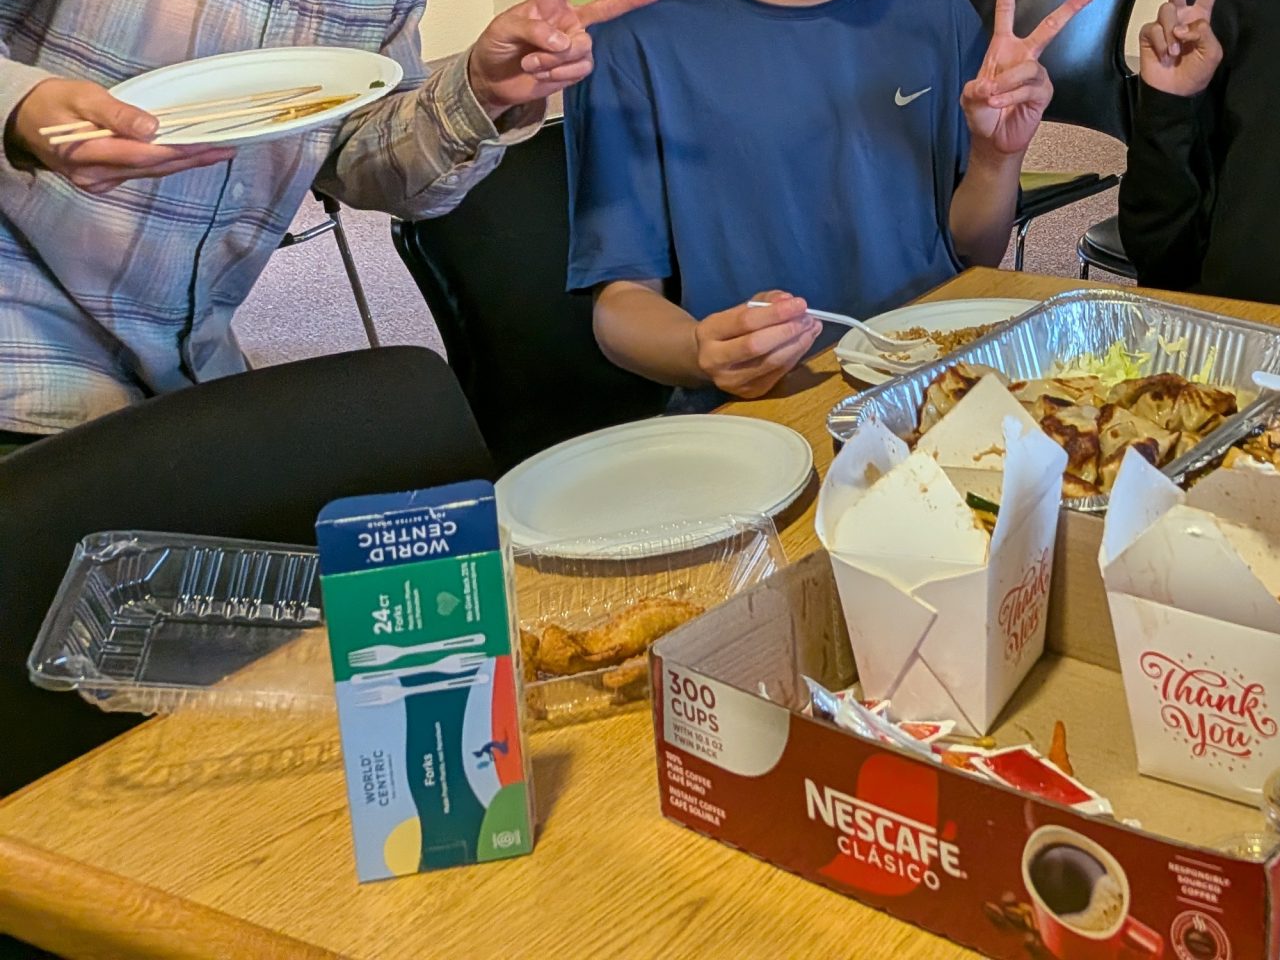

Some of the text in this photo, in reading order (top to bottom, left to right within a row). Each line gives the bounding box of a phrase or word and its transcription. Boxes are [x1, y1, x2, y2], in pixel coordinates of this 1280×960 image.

[358, 521, 458, 548] CENTRIC
[368, 538, 450, 563] WORLD
[393, 604, 405, 632] Forks
[668, 669, 716, 710] 300
[1139, 651, 1279, 737] Thank
[671, 697, 720, 733] CUPS
[673, 722, 693, 737] WITH
[1161, 704, 1254, 758] You
[674, 732, 718, 759] TWIN PACK
[361, 757, 376, 805] WORLD
[373, 750, 390, 806] CENTRIC
[422, 753, 435, 787] Forks
[666, 760, 712, 789] PURE COFFEE
[669, 785, 726, 819] INSTANT COFFEE
[1181, 884, 1218, 903] COFFEE
